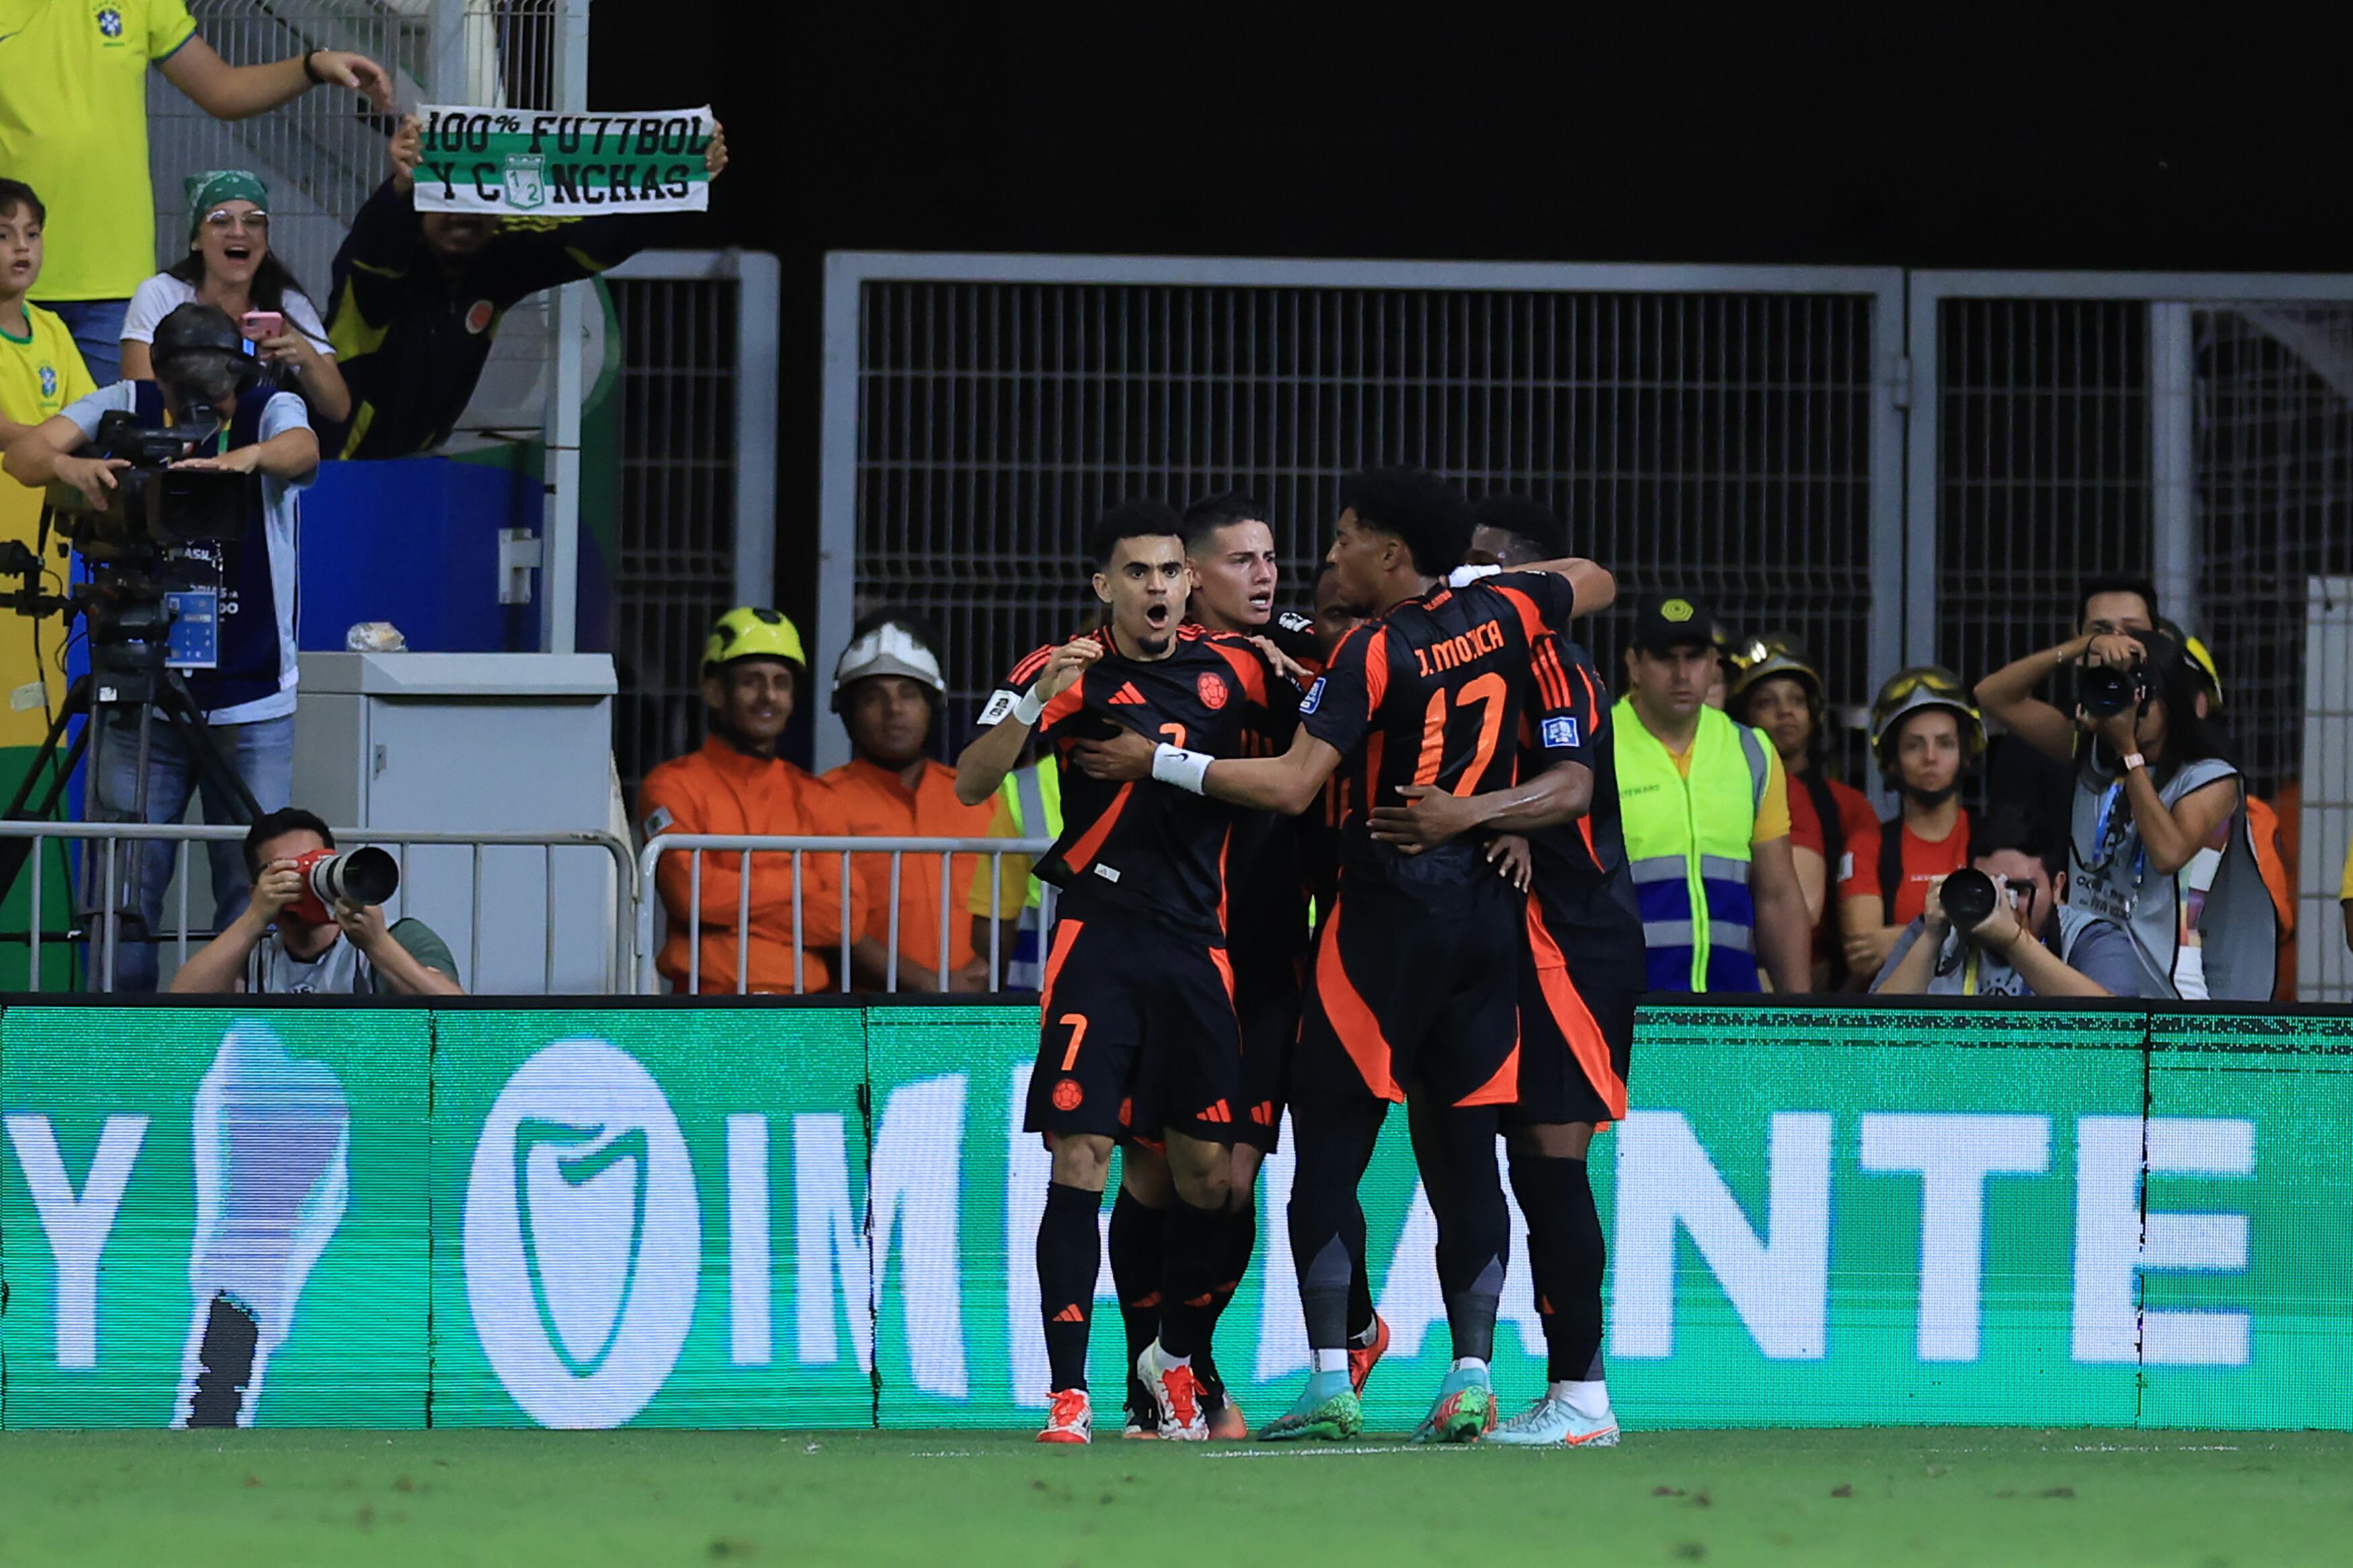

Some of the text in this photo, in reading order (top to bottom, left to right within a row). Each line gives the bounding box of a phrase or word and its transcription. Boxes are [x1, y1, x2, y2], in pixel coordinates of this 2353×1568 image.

[426, 112, 521, 153] 100%
[429, 162, 455, 200] Y
[1406, 672, 1507, 807] 17
[1059, 1014, 1088, 1071] 7
[4, 1113, 151, 1369] Y
